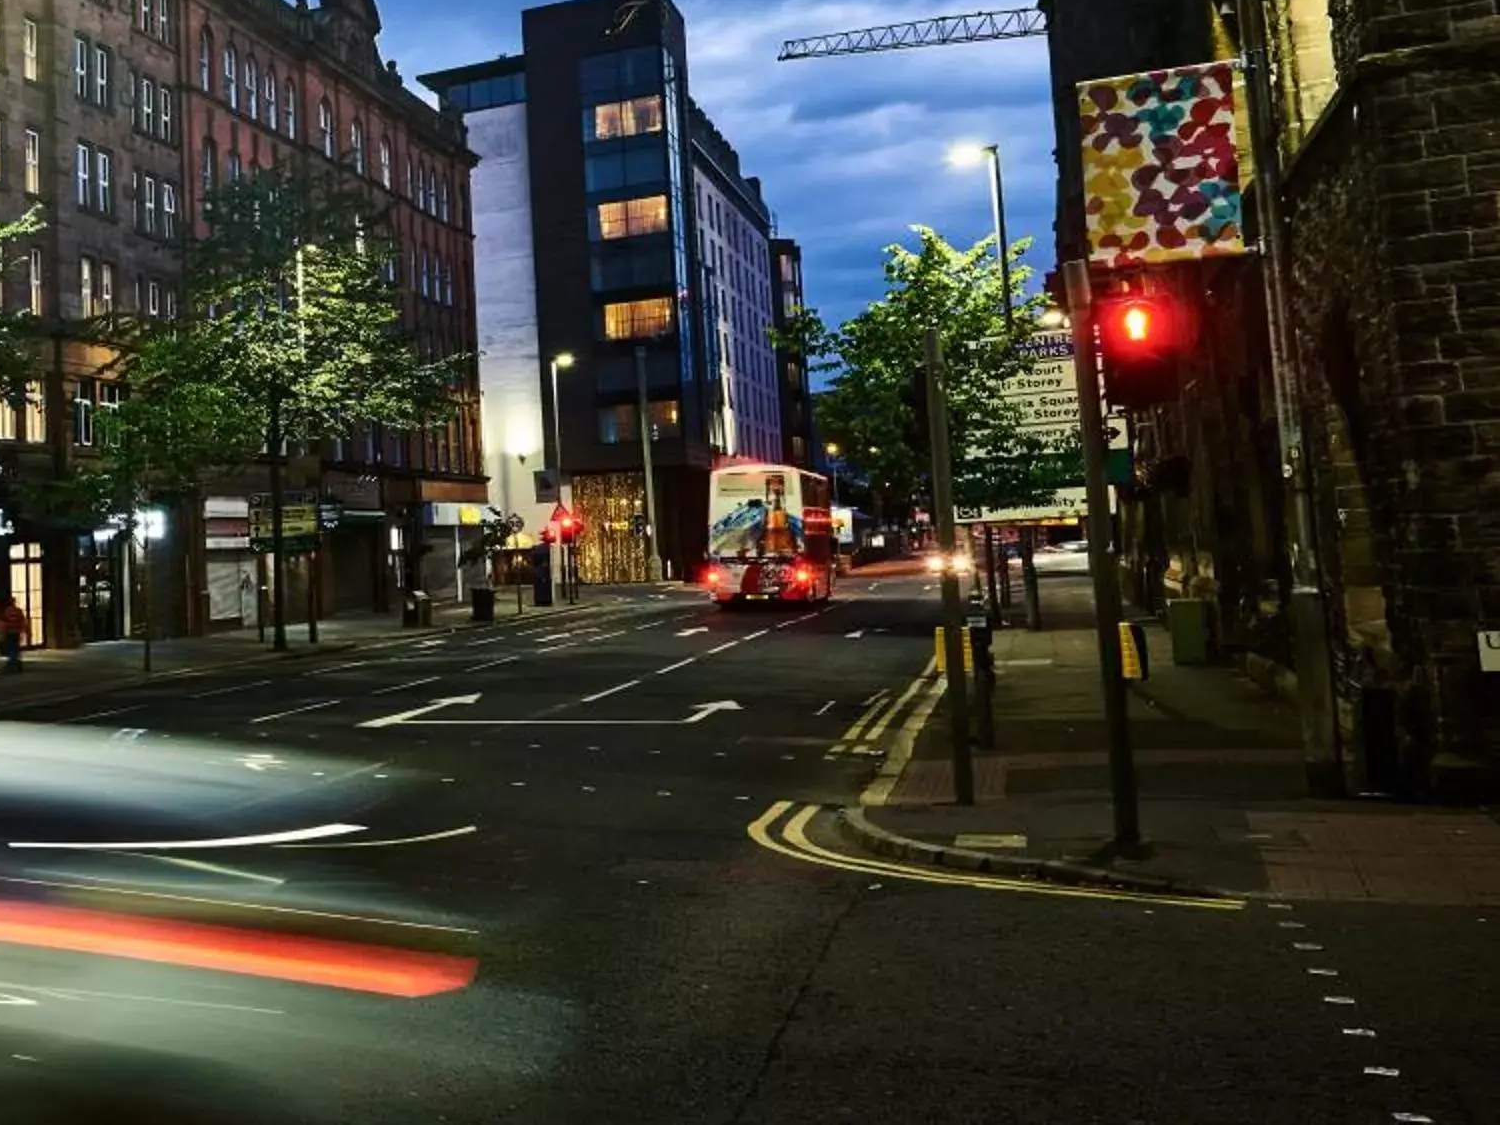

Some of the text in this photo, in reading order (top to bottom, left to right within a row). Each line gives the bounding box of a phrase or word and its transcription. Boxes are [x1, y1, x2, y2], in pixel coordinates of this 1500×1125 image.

[1019, 345, 1069, 358] PARKS
[1039, 396, 1080, 407] Squar
[1001, 408, 1079, 421] ulti-Storey
